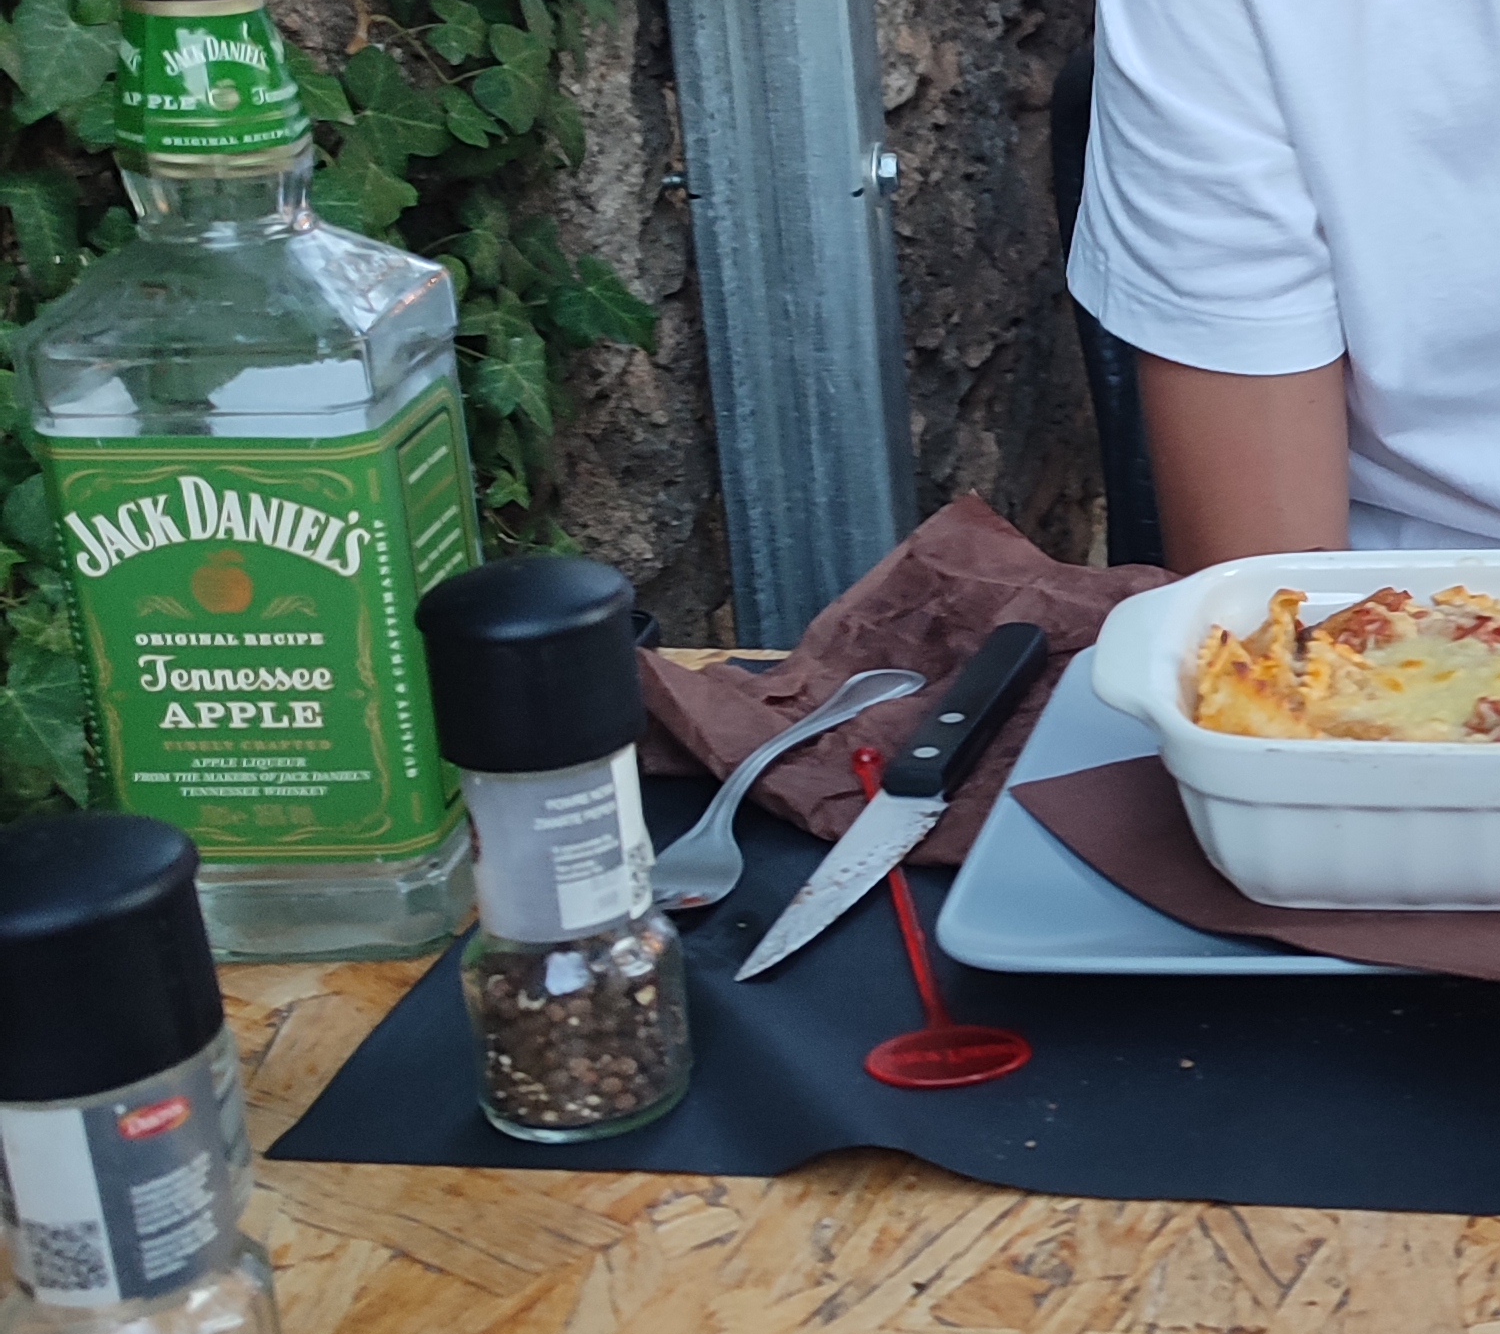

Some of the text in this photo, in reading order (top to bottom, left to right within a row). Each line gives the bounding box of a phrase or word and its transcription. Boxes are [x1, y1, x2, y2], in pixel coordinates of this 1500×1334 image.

[161, 129, 291, 147] ORIGINAL RECIP
[64, 494, 187, 577] JACK
[178, 475, 371, 577] DANIEL'S
[135, 633, 324, 646] ORIGINAL RECIPE
[138, 654, 335, 692] Tennessee
[159, 701, 325, 729] APPLE
[191, 757, 306, 769] APPLE LIQUEUR
[134, 772, 170, 782] FROM
[174, 772, 201, 782] THE
[203, 772, 258, 782] MAKERS
[260, 772, 278, 783] OF
[278, 772, 310, 784] JACK
[180, 786, 328, 796] TENNESSEE WHISKEY
